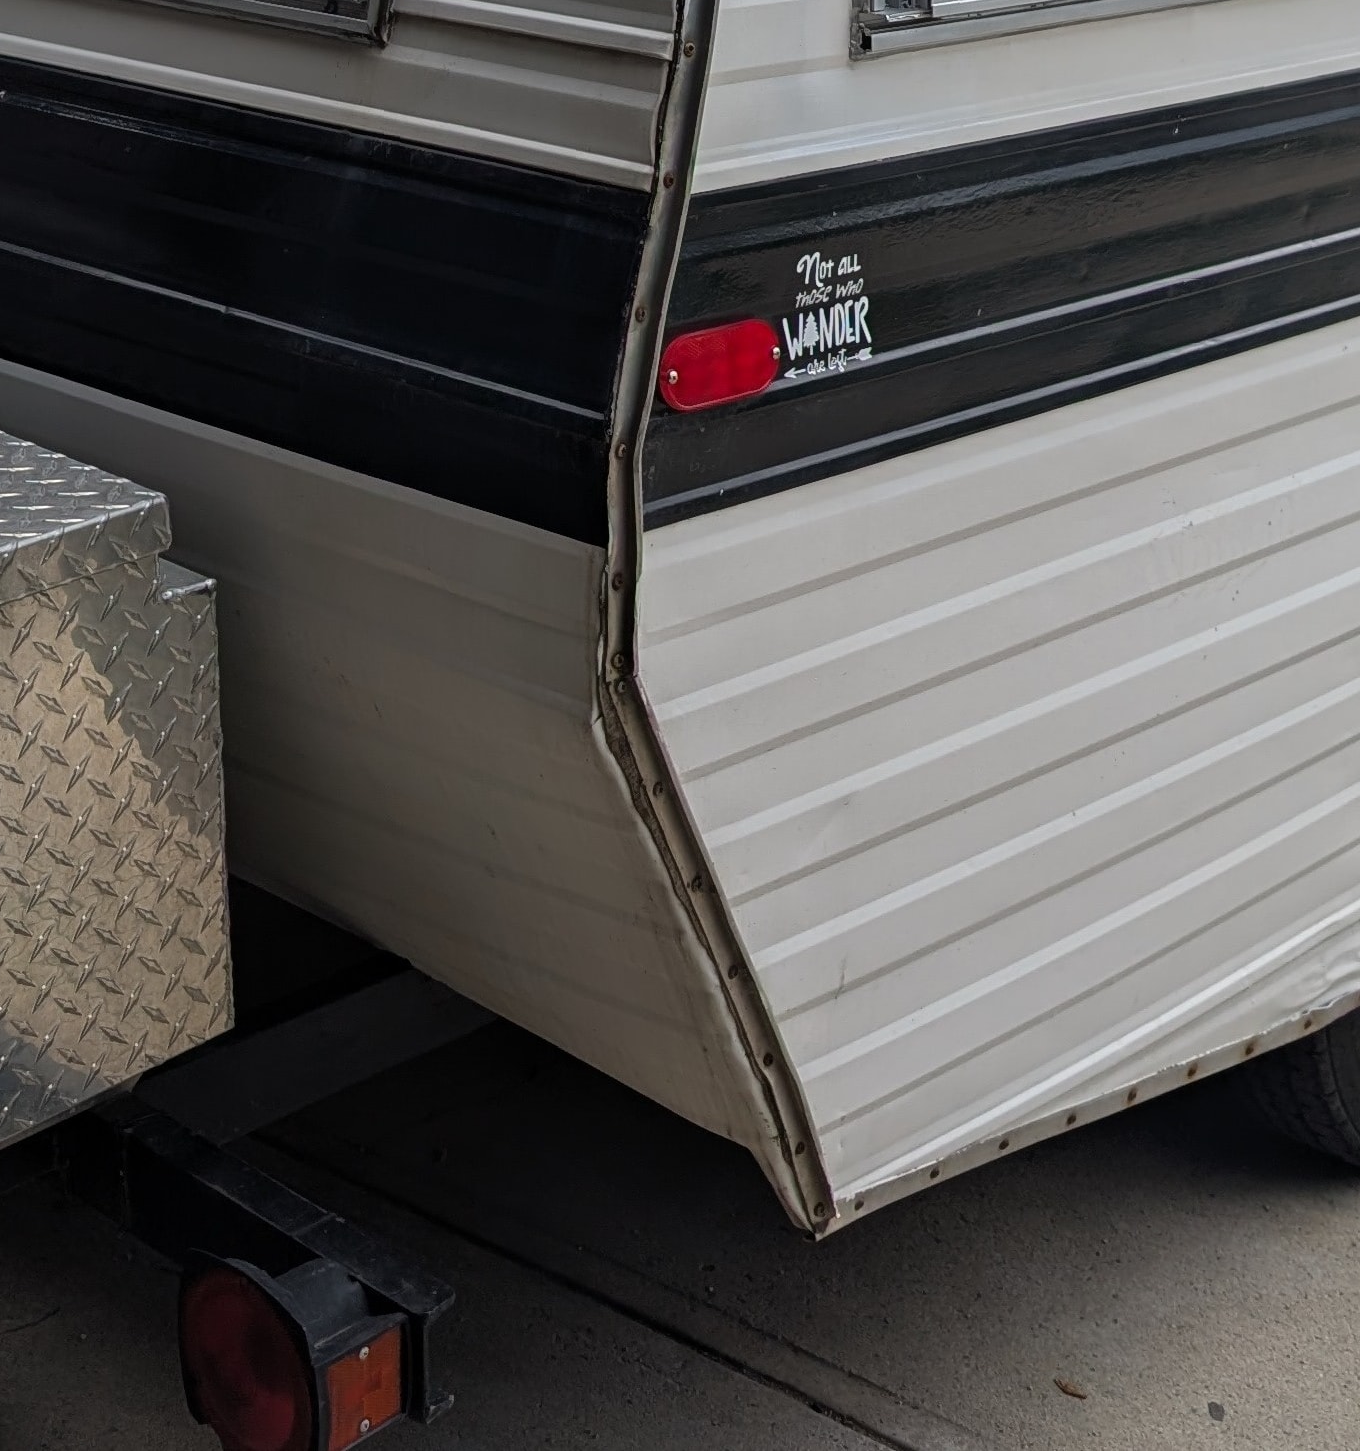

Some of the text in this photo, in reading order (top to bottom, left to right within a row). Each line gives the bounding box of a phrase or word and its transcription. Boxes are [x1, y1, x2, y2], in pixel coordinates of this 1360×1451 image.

[796, 251, 834, 288] Not
[795, 284, 833, 309] those
[806, 358, 826, 375] are
